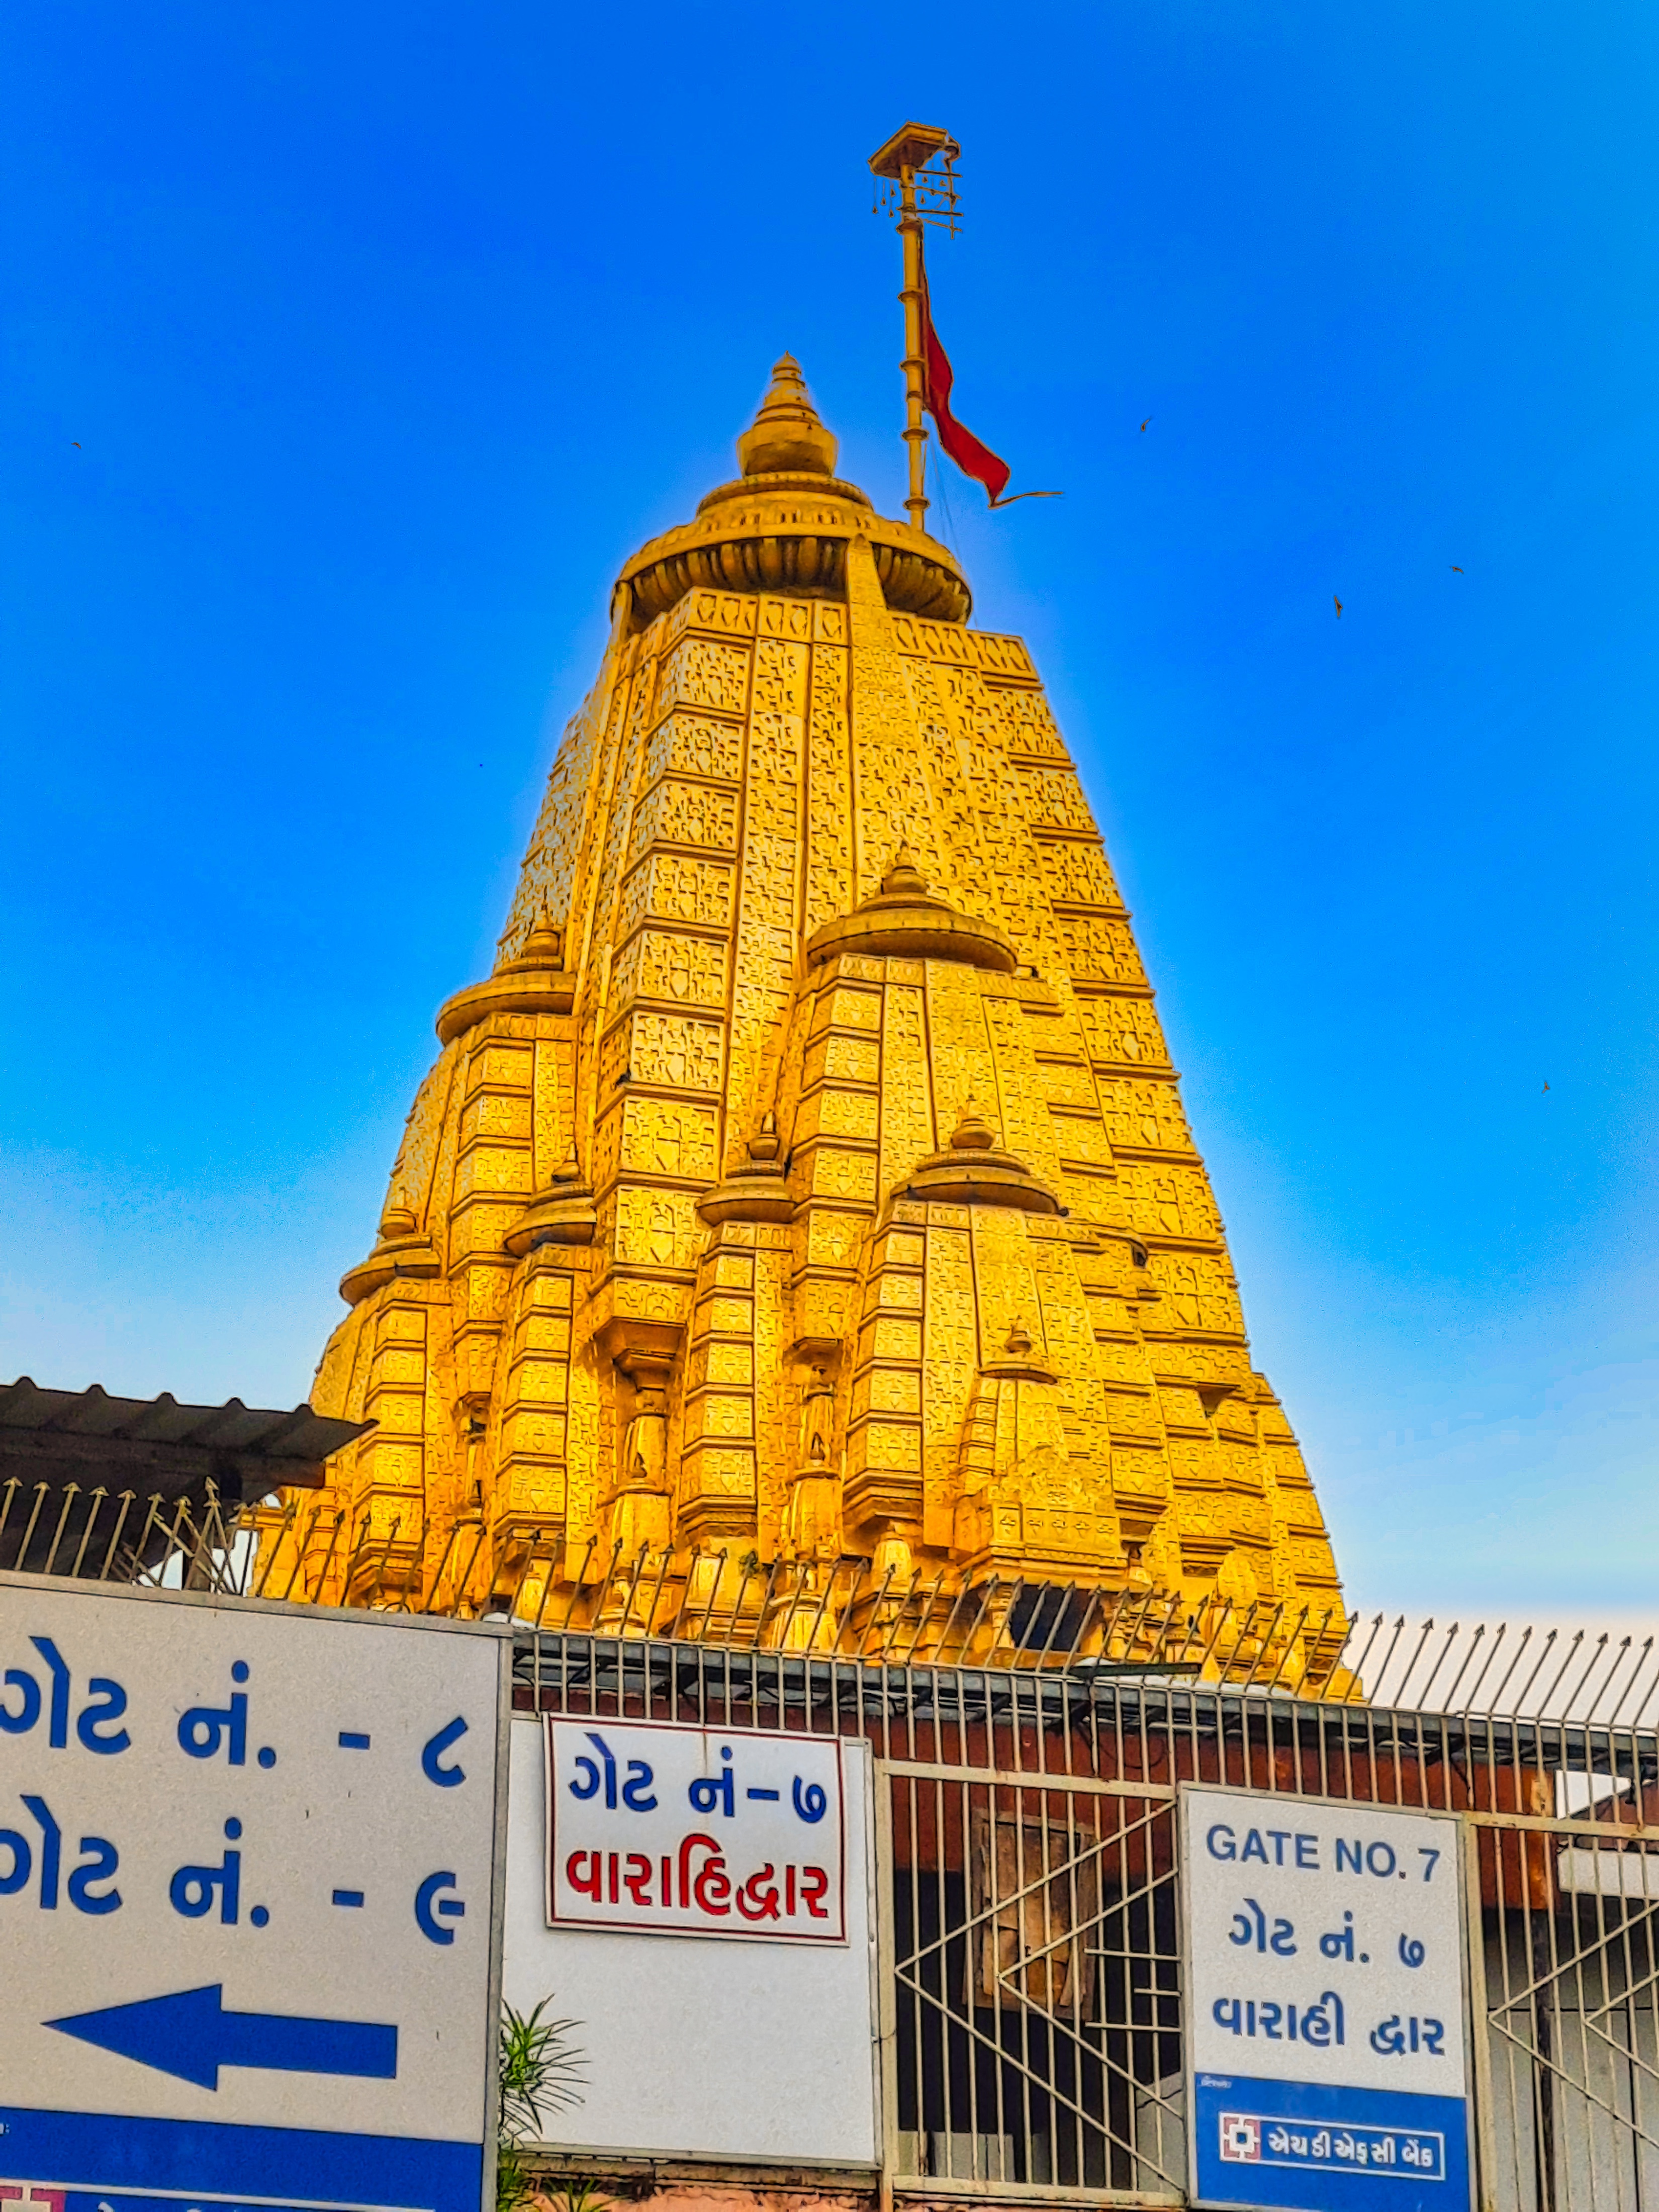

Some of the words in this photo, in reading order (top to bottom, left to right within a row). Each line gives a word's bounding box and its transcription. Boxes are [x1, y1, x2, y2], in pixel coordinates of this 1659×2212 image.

[0, 1636, 131, 1755] ગેટ
[177, 1660, 276, 1769] નં.
[339, 1732, 371, 1750] -
[421, 1716, 468, 1788] ૮
[568, 1732, 658, 1812] ગેટ
[0, 1794, 123, 1915] ગેટ
[169, 1817, 269, 1928] નં.
[332, 1889, 364, 1907] -
[415, 1871, 466, 1946] ૯
[1207, 1825, 1320, 1870] GATE
[1335, 1838, 1407, 1879] NO.
[1418, 1848, 1440, 1882] 7
[1229, 1898, 1297, 1956] ગેટ
[1320, 1910, 1370, 1963] નં.
[1399, 1933, 1425, 1968] ૭
[1212, 1991, 1345, 2047] વારાહી
[1370, 2015, 1445, 2056] દ્વાર
[1401, 2139, 1433, 2168] બેંક
